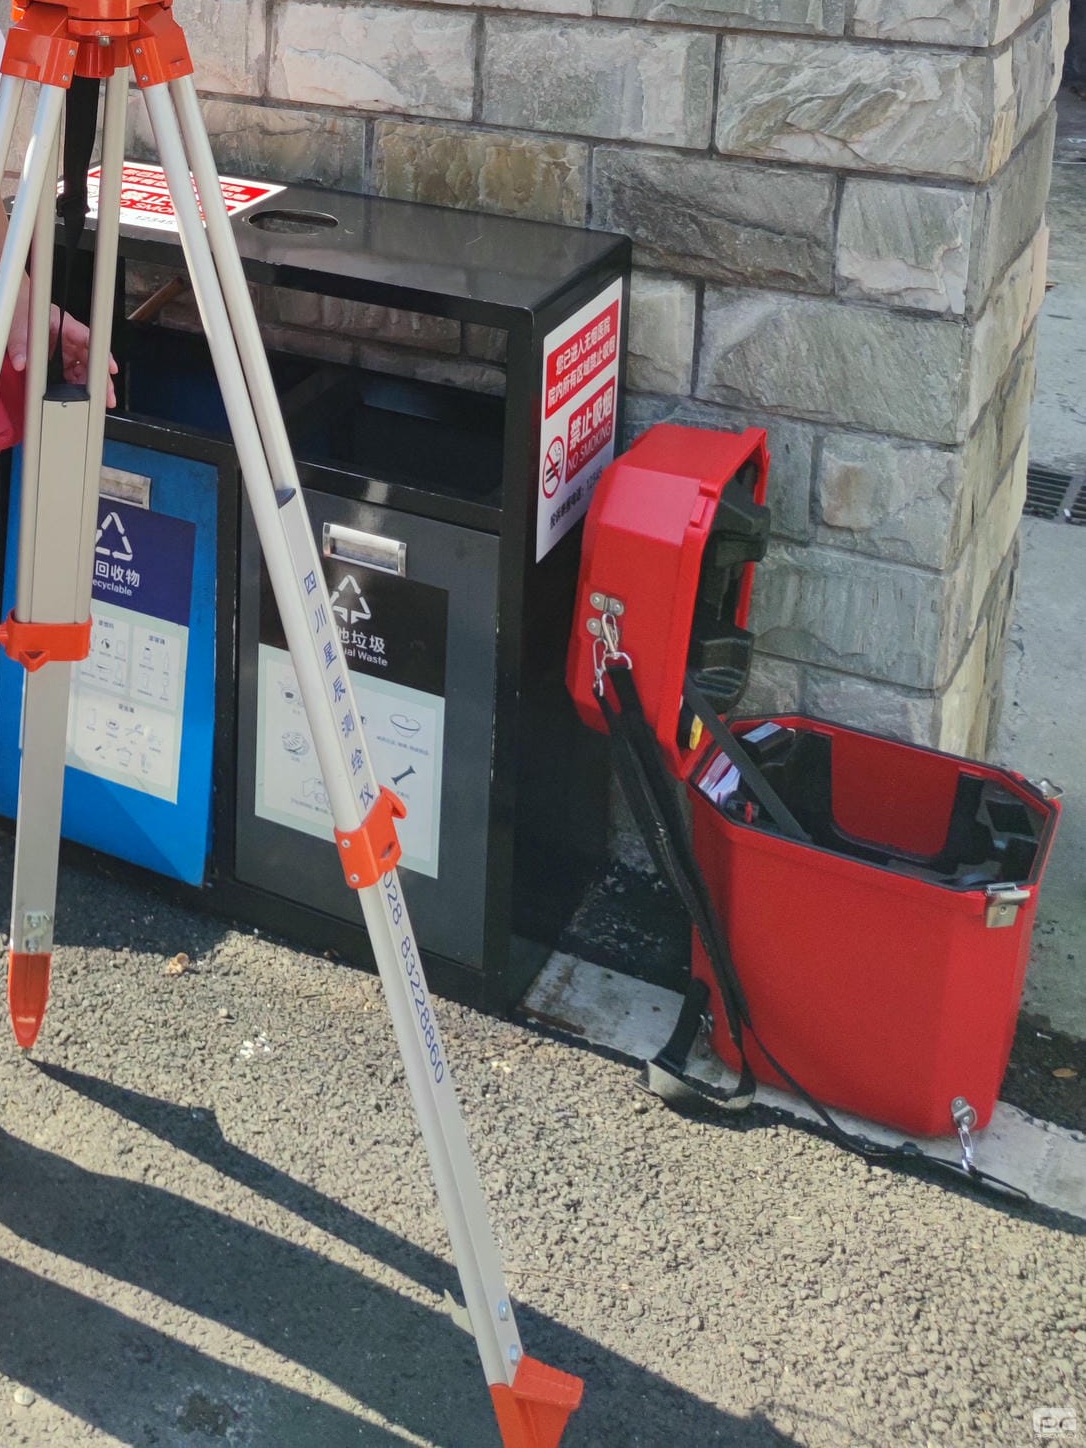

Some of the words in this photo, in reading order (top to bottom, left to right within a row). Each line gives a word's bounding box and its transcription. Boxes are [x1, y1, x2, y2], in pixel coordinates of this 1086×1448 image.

[569, 386, 613, 451] 禁止吸烟
[567, 451, 579, 472] NO
[579, 420, 612, 463] SMOKING
[92, 578, 133, 596] ecyclable
[94, 560, 141, 588] 回收物
[338, 626, 386, 655] 他垃圾
[358, 649, 389, 667] Waste
[304, 569, 375, 810] 四川星辰测绘仪
